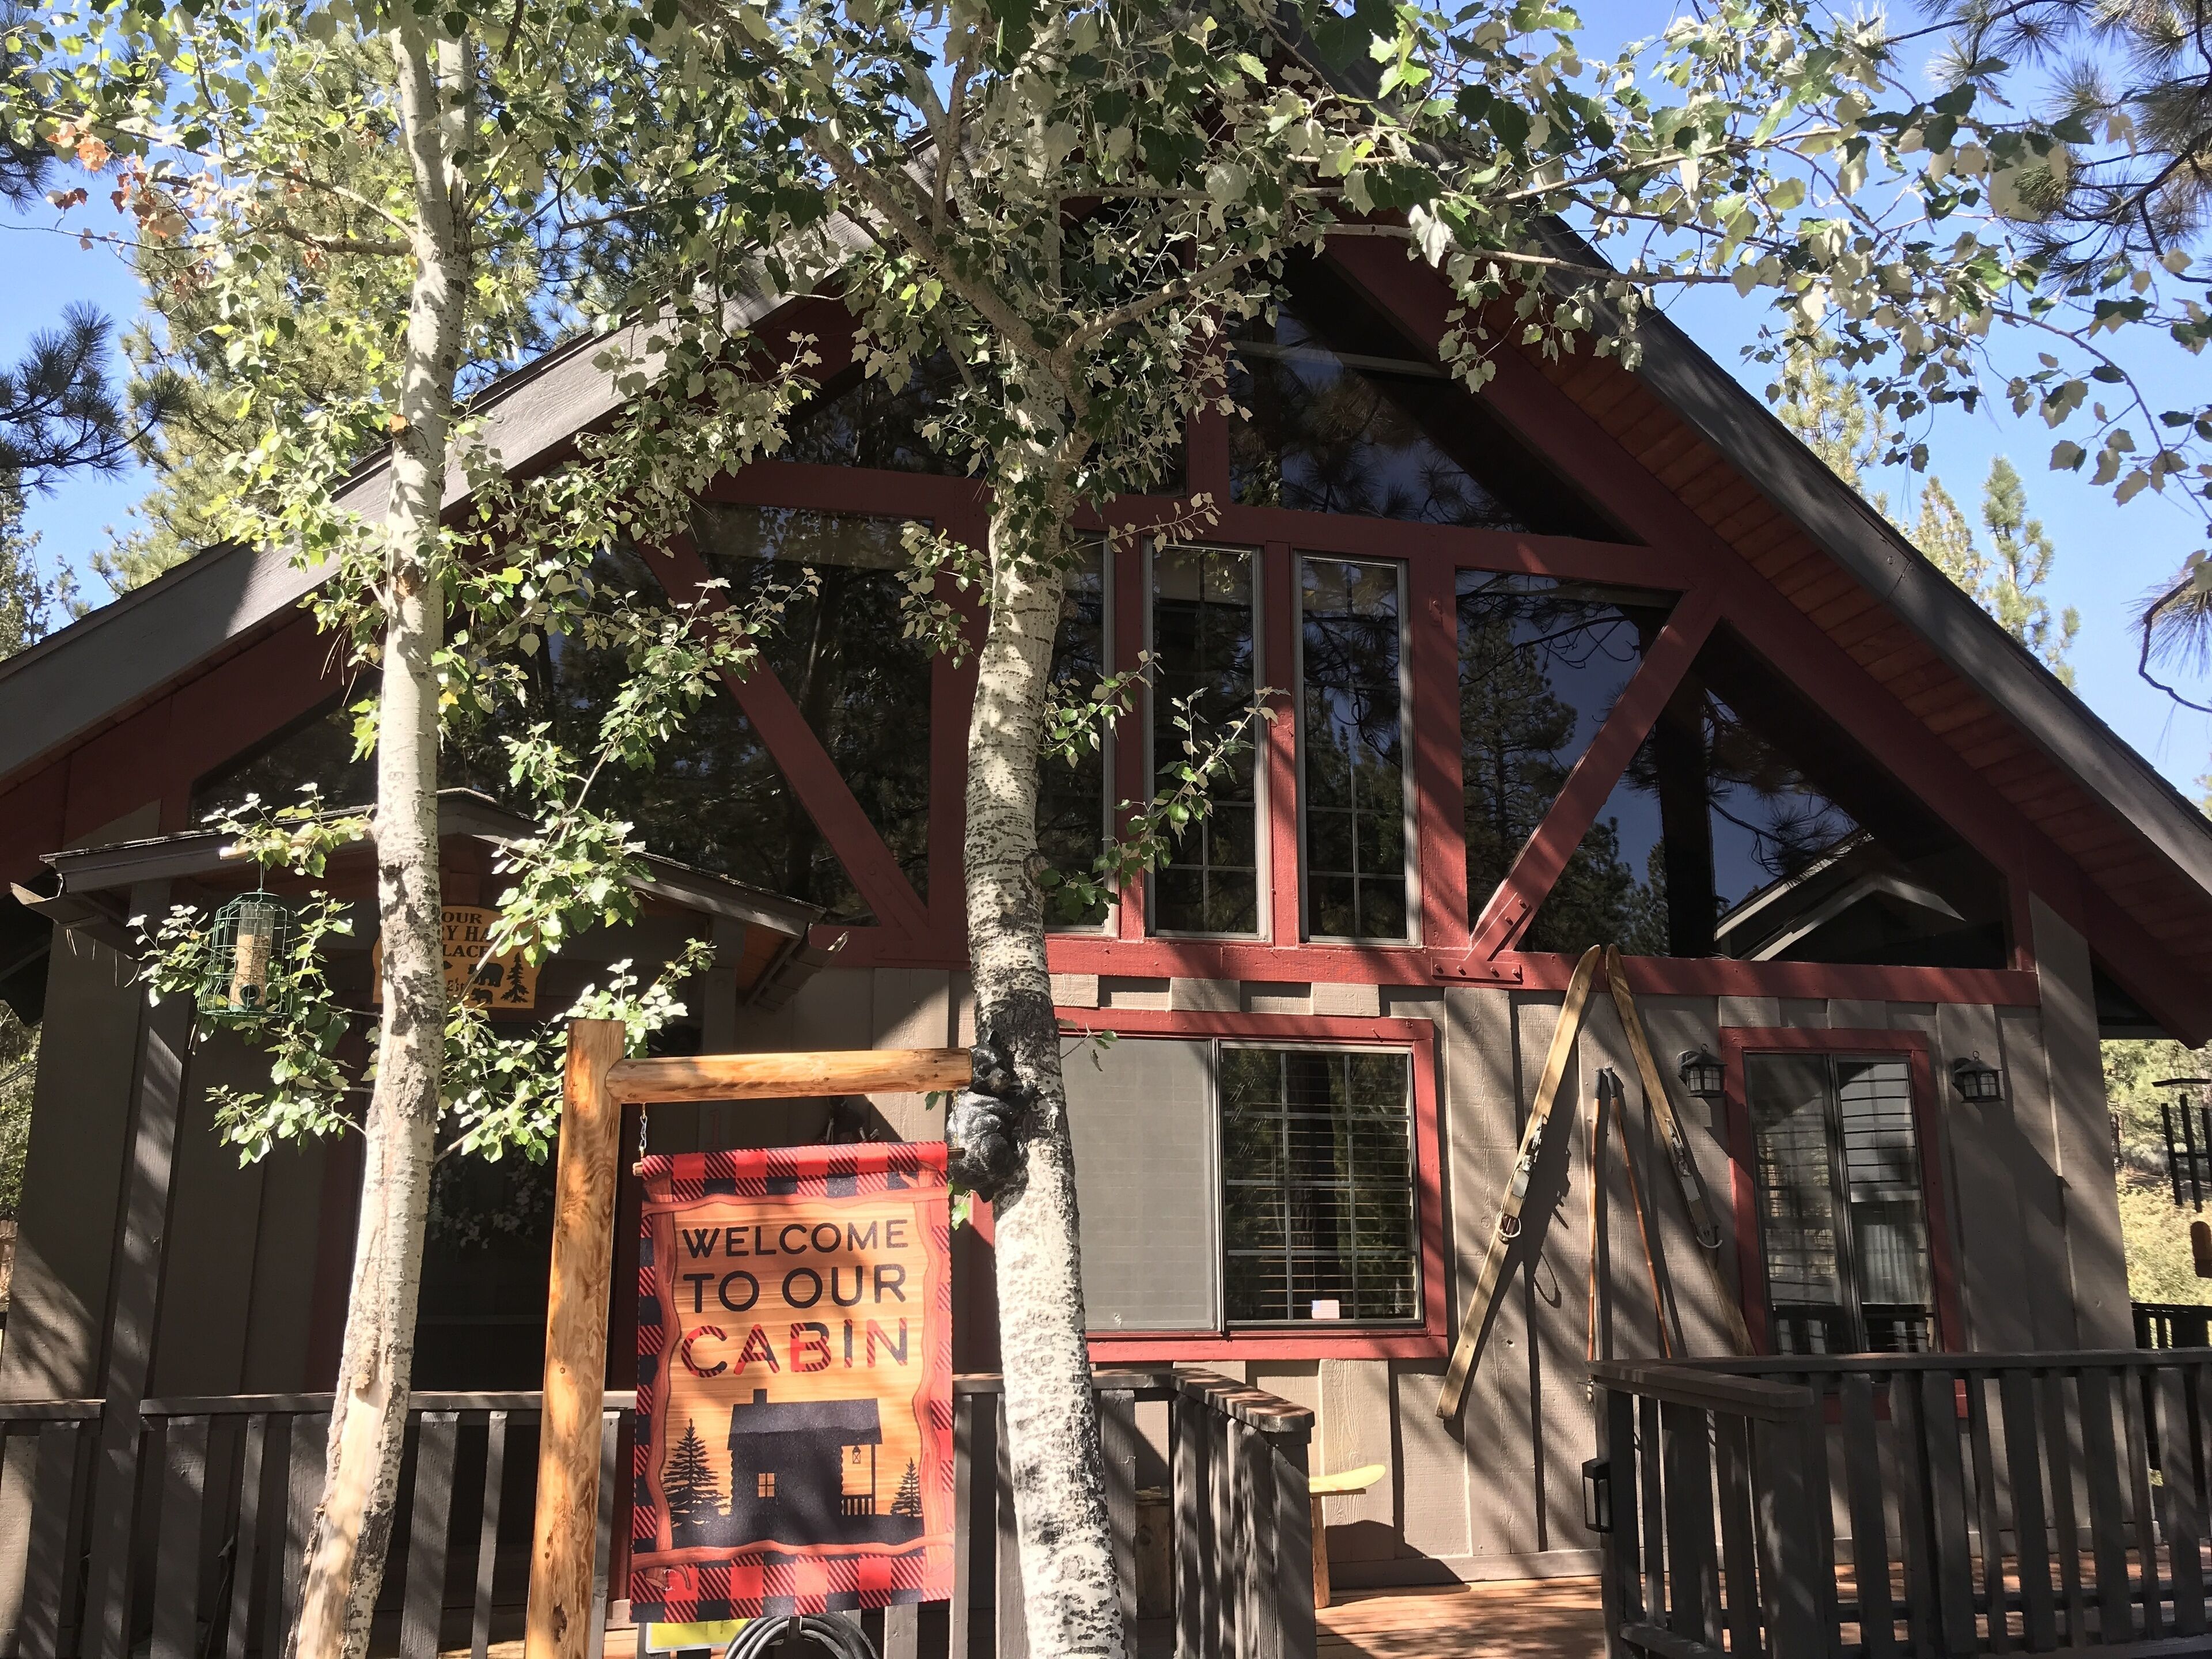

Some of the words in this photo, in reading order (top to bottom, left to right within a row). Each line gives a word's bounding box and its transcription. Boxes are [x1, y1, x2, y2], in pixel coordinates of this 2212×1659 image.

[441, 912, 482, 924] OUR
[442, 944, 493, 957] LACE
[681, 1219, 908, 1259] WELCOME
[683, 1270, 760, 1313] TO
[782, 1264, 906, 1309] OUR
[681, 1317, 908, 1378] CABIN
